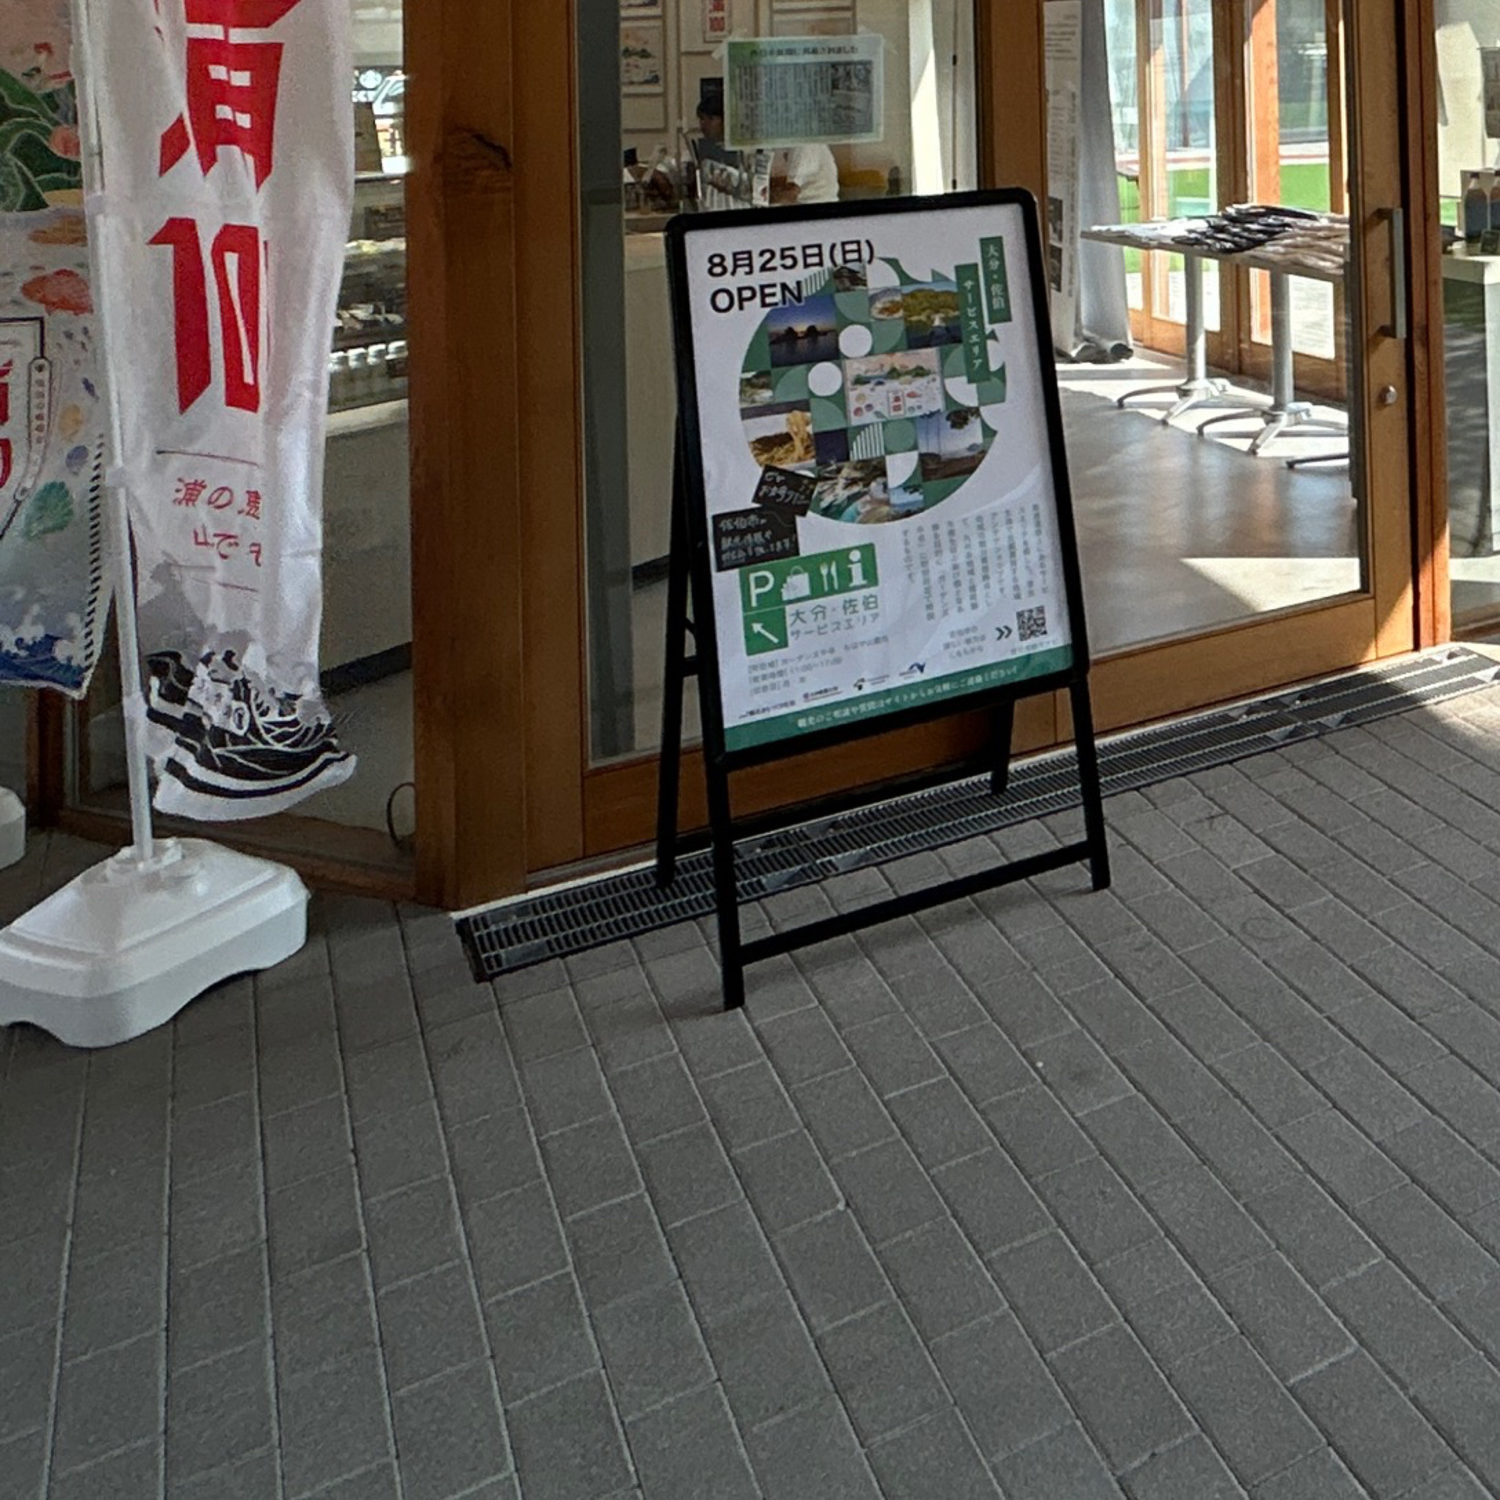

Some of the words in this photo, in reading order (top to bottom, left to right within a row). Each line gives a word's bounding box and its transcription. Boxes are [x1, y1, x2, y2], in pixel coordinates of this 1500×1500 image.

[707, 239, 875, 277] 8月25日(日)
[710, 280, 804, 314] OPEN
[963, 280, 983, 370] サービスエリア
[750, 570, 775, 607] P
[789, 594, 879, 626] 大分・佐伯
[790, 613, 880, 641] サービスエリア
